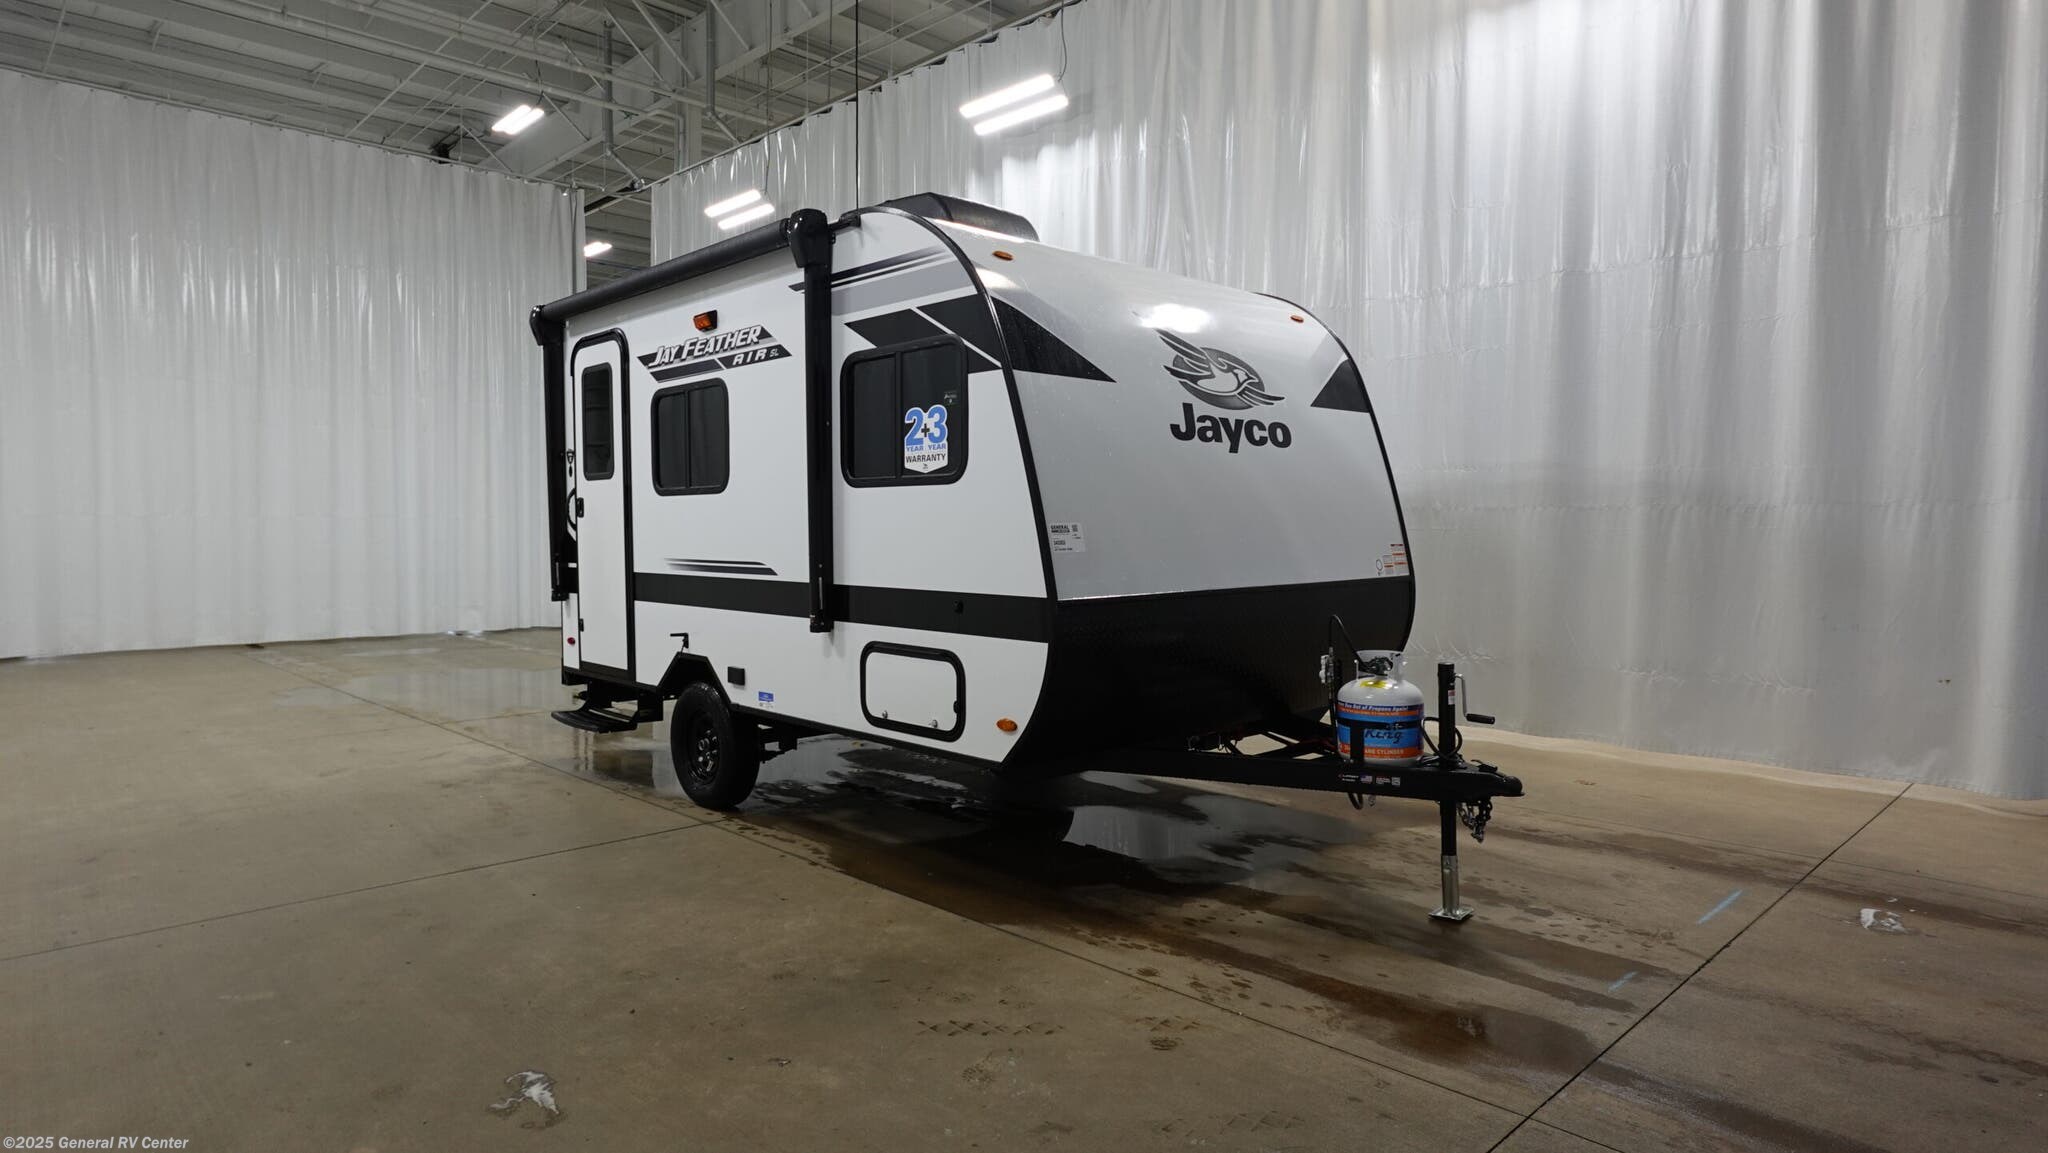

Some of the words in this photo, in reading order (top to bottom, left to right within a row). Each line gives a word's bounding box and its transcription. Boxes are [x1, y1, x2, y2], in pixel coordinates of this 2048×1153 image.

[649, 345, 682, 367] JAY
[681, 325, 763, 361] FEATHER
[733, 348, 767, 366] AIR
[769, 348, 780, 358] SL
[1170, 402, 1292, 454] Jayco
[928, 443, 947, 451] YEAR
[906, 454, 947, 463] WARRANTY
[1365, 730, 1403, 744] King
